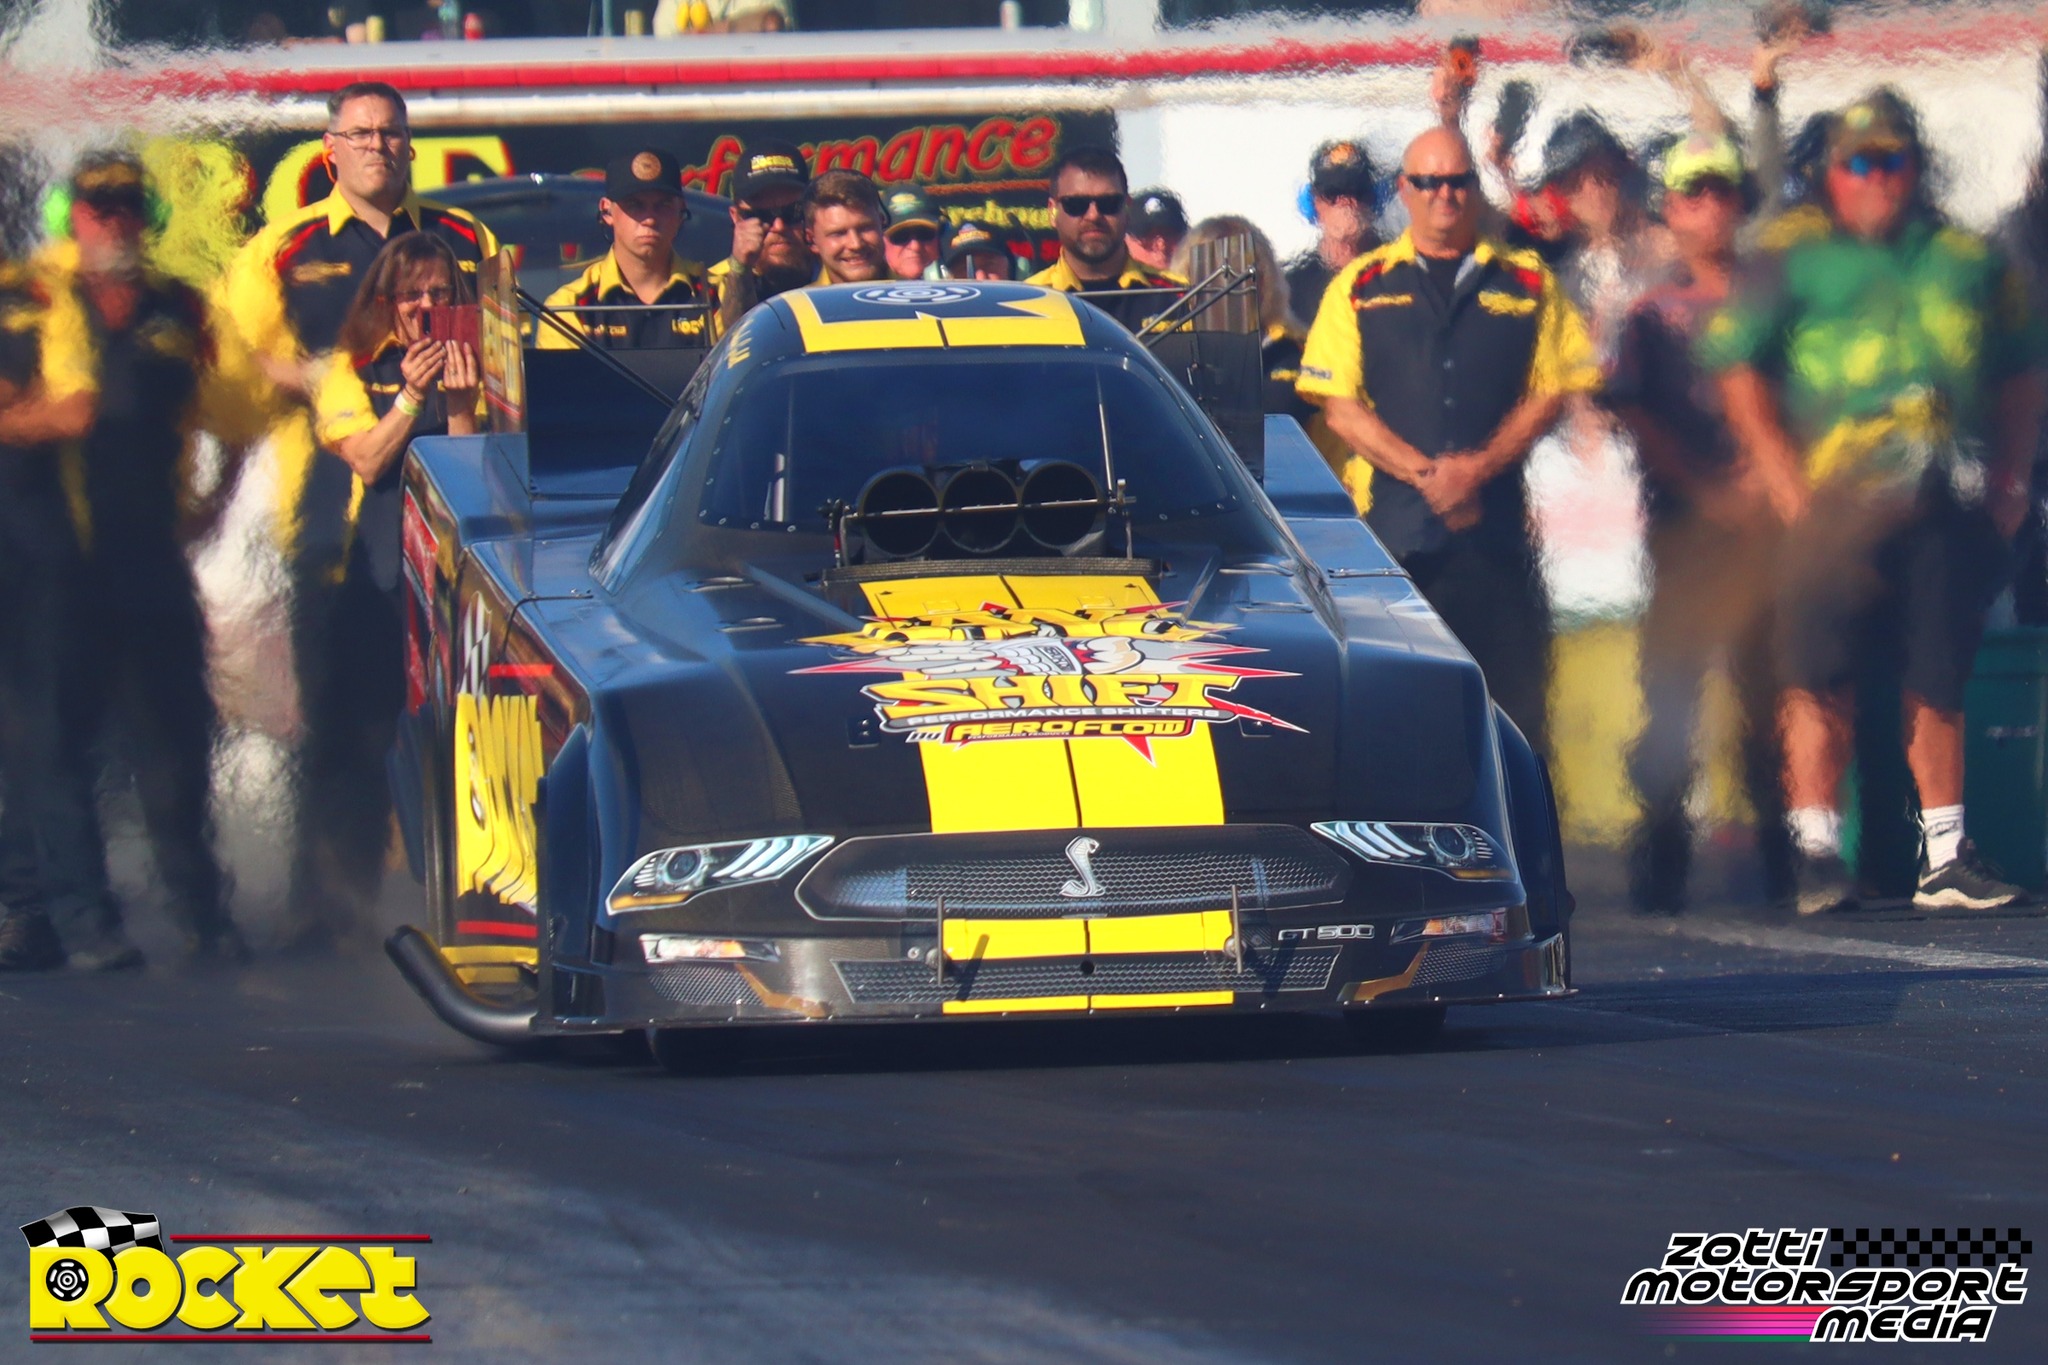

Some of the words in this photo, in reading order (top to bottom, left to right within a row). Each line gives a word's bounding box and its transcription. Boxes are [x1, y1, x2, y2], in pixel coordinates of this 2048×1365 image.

[868, 673, 1240, 719] SHIFT
[907, 707, 1097, 726] PERFORMANCE
[1101, 707, 1220, 717] SHIFTERS
[950, 719, 1186, 742] AEROFLOW
